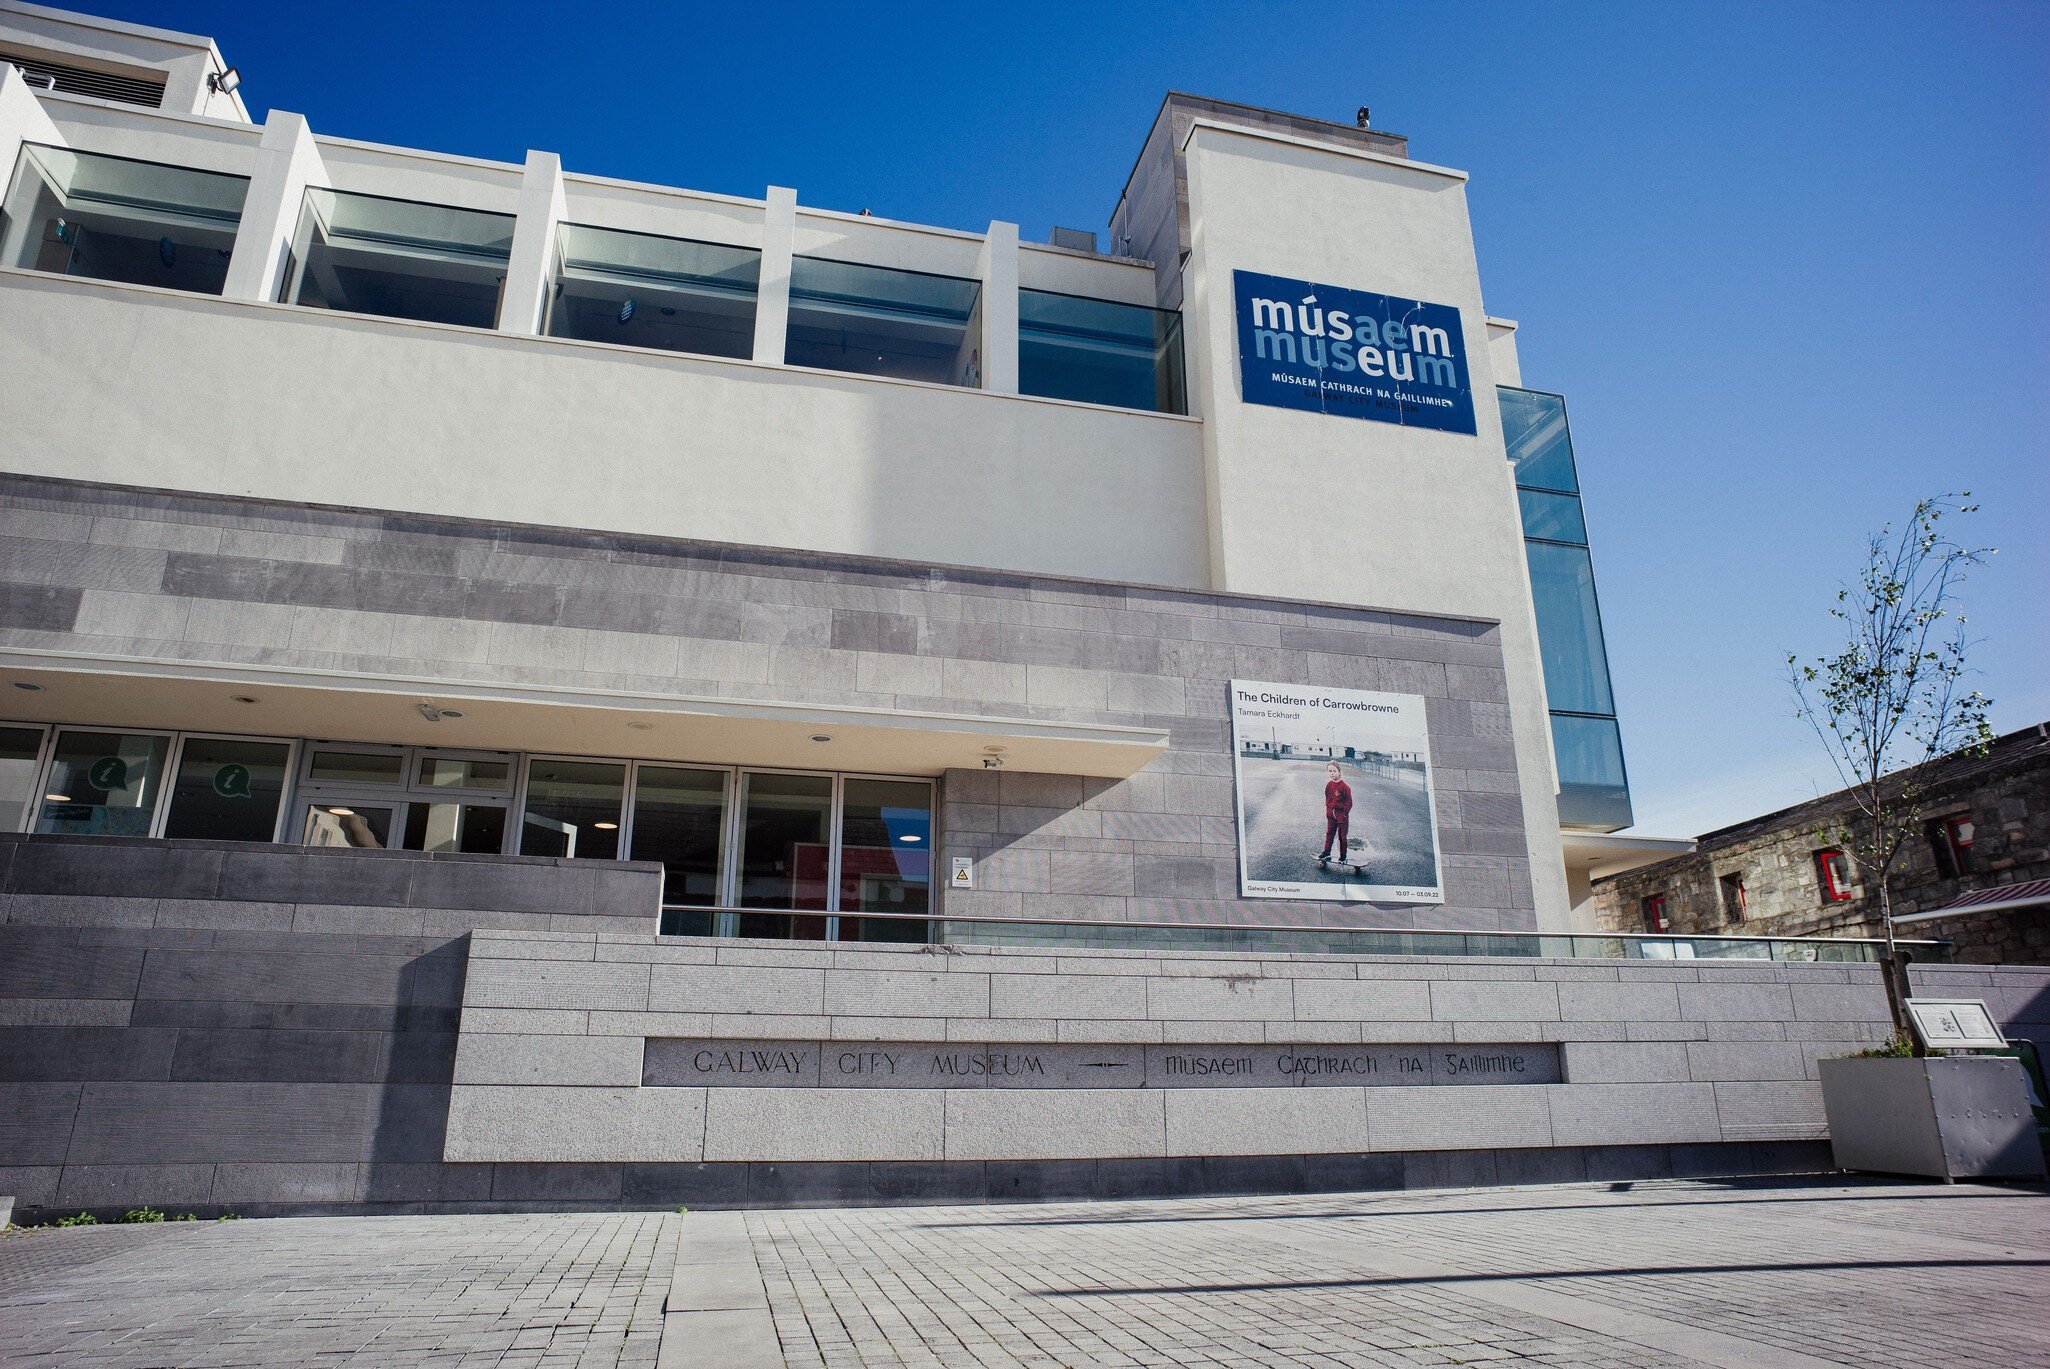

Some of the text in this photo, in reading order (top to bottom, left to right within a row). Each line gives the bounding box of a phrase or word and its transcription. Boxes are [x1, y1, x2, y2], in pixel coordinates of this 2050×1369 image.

[1251, 294, 1451, 358] músaem
[1254, 328, 1457, 389] museum
[1271, 372, 1448, 408] MÚSAEM CATHRACH NA GAILLIMHE
[1349, 395, 1371, 406] CITY
[1237, 690, 1400, 714] The Children of Carrowbrowne
[1238, 707, 1300, 720] Tamara Eckhardt
[1247, 885, 1301, 894] Galway City Museum
[694, 1050, 1045, 1076] GALWAY CITY MUSEUM
